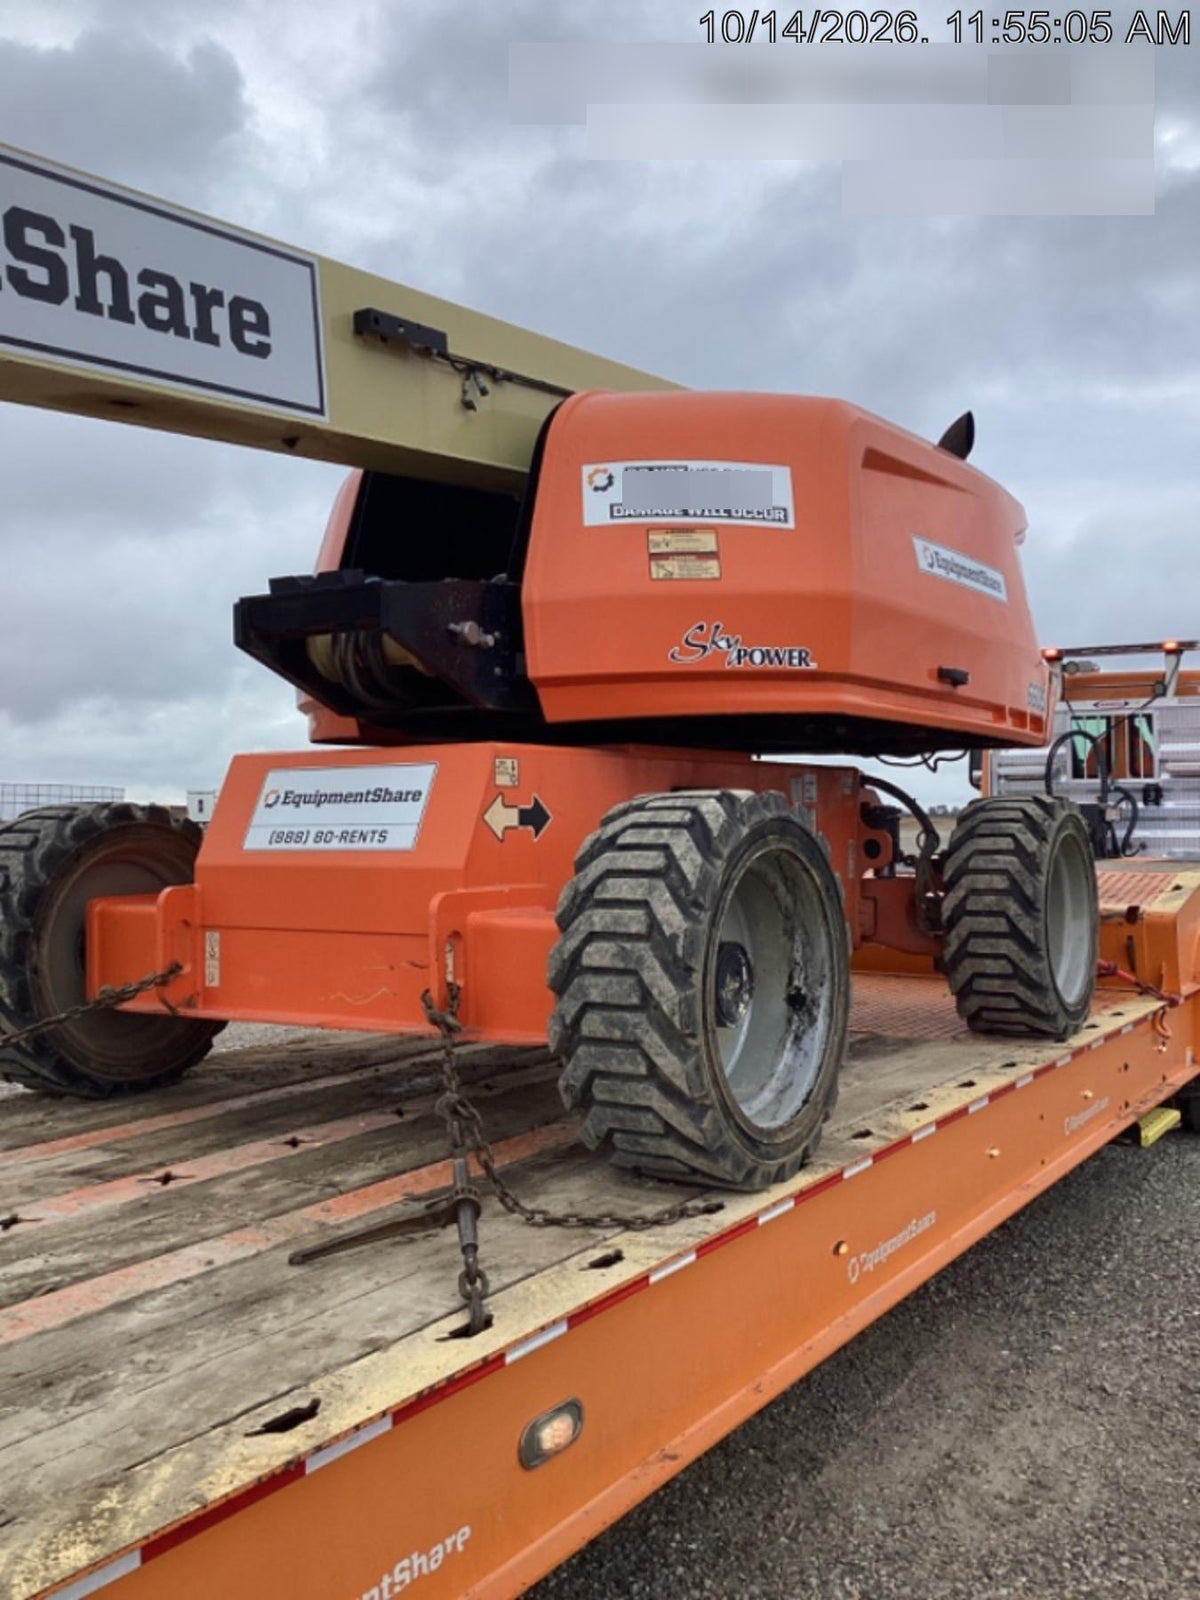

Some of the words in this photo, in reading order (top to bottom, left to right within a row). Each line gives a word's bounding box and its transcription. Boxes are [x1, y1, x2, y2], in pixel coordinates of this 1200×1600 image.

[0, 205, 272, 360] Share
[668, 621, 741, 669] Sky
[736, 647, 812, 668] POWER
[280, 786, 423, 809] EquipmentShare
[268, 829, 311, 846] (888)
[356, 1524, 472, 1600] ntShare
